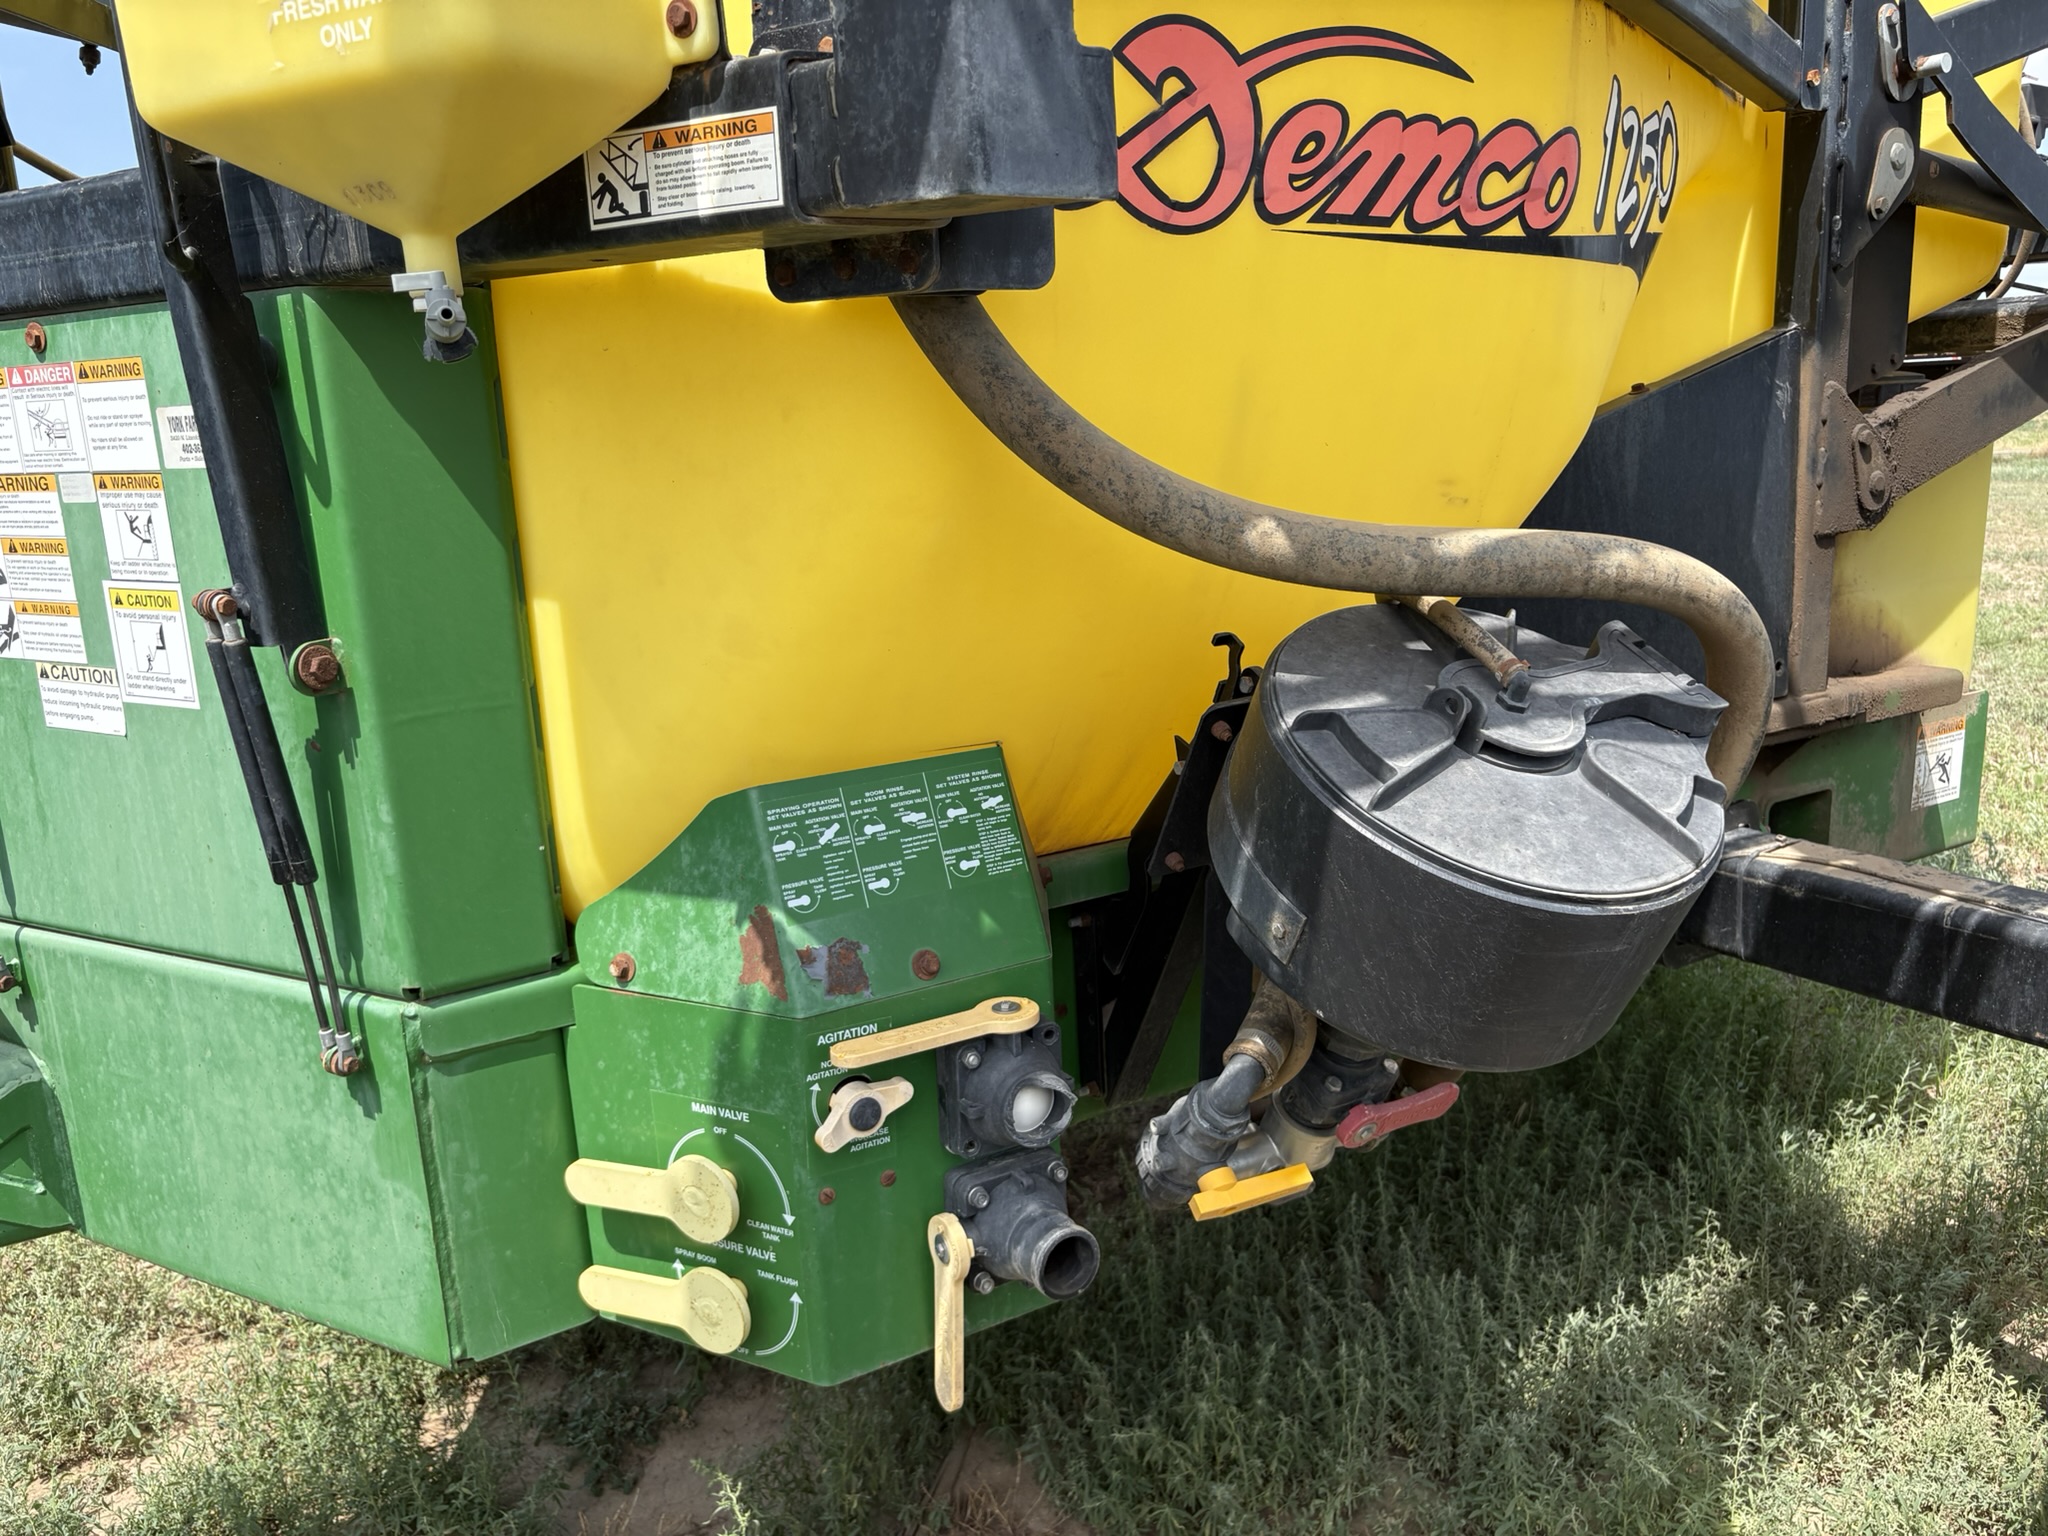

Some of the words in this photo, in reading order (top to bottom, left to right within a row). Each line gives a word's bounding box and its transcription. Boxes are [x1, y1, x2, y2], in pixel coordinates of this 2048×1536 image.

[320, 16, 372, 48] ONLY
[675, 119, 757, 143] WARNING
[1111, 12, 1581, 235] Demco
[1595, 73, 1679, 248] 1250
[661, 149, 683, 159] prevent
[734, 139, 751, 147] death
[24, 366, 71, 384] DANGER
[89, 362, 141, 379] WARNING
[0, 476, 49, 491] ARNING
[110, 476, 160, 489] WARNING
[19, 542, 64, 554] WARNING
[127, 594, 172, 608] CAUTION
[31, 604, 70, 615] WARNING
[50, 664, 113, 685] CAUTION
[946, 772, 970, 781] SYSTEM
[971, 769, 989, 777] RINSE
[948, 779, 970, 787] VALVES
[864, 789, 884, 797] BOOM
[864, 795, 887, 803] VALVES
[899, 788, 921, 796] SHOWN
[767, 805, 800, 815] SPRAYING
[802, 798, 839, 808] OPERATION
[781, 810, 805, 818] VALVES
[819, 803, 842, 812] SHOWN
[817, 1023, 878, 1046] AGITATION
[821, 1060, 832, 1069] NO
[806, 1067, 848, 1082] AGITATION
[691, 1101, 717, 1116] MAIN
[718, 1107, 750, 1122] VALVE
[713, 1126, 727, 1135] OFF
[850, 1136, 890, 1152] AGITATION
[747, 1219, 770, 1231] CLEAN
[770, 1224, 794, 1237] WATER
[761, 1231, 780, 1242] TANK
[674, 1246, 695, 1258] SPRAY
[696, 1253, 717, 1264] BOOM
[745, 1246, 777, 1262] VALVE
[757, 1269, 775, 1280] TANK
[776, 1273, 799, 1286] FLUSH
